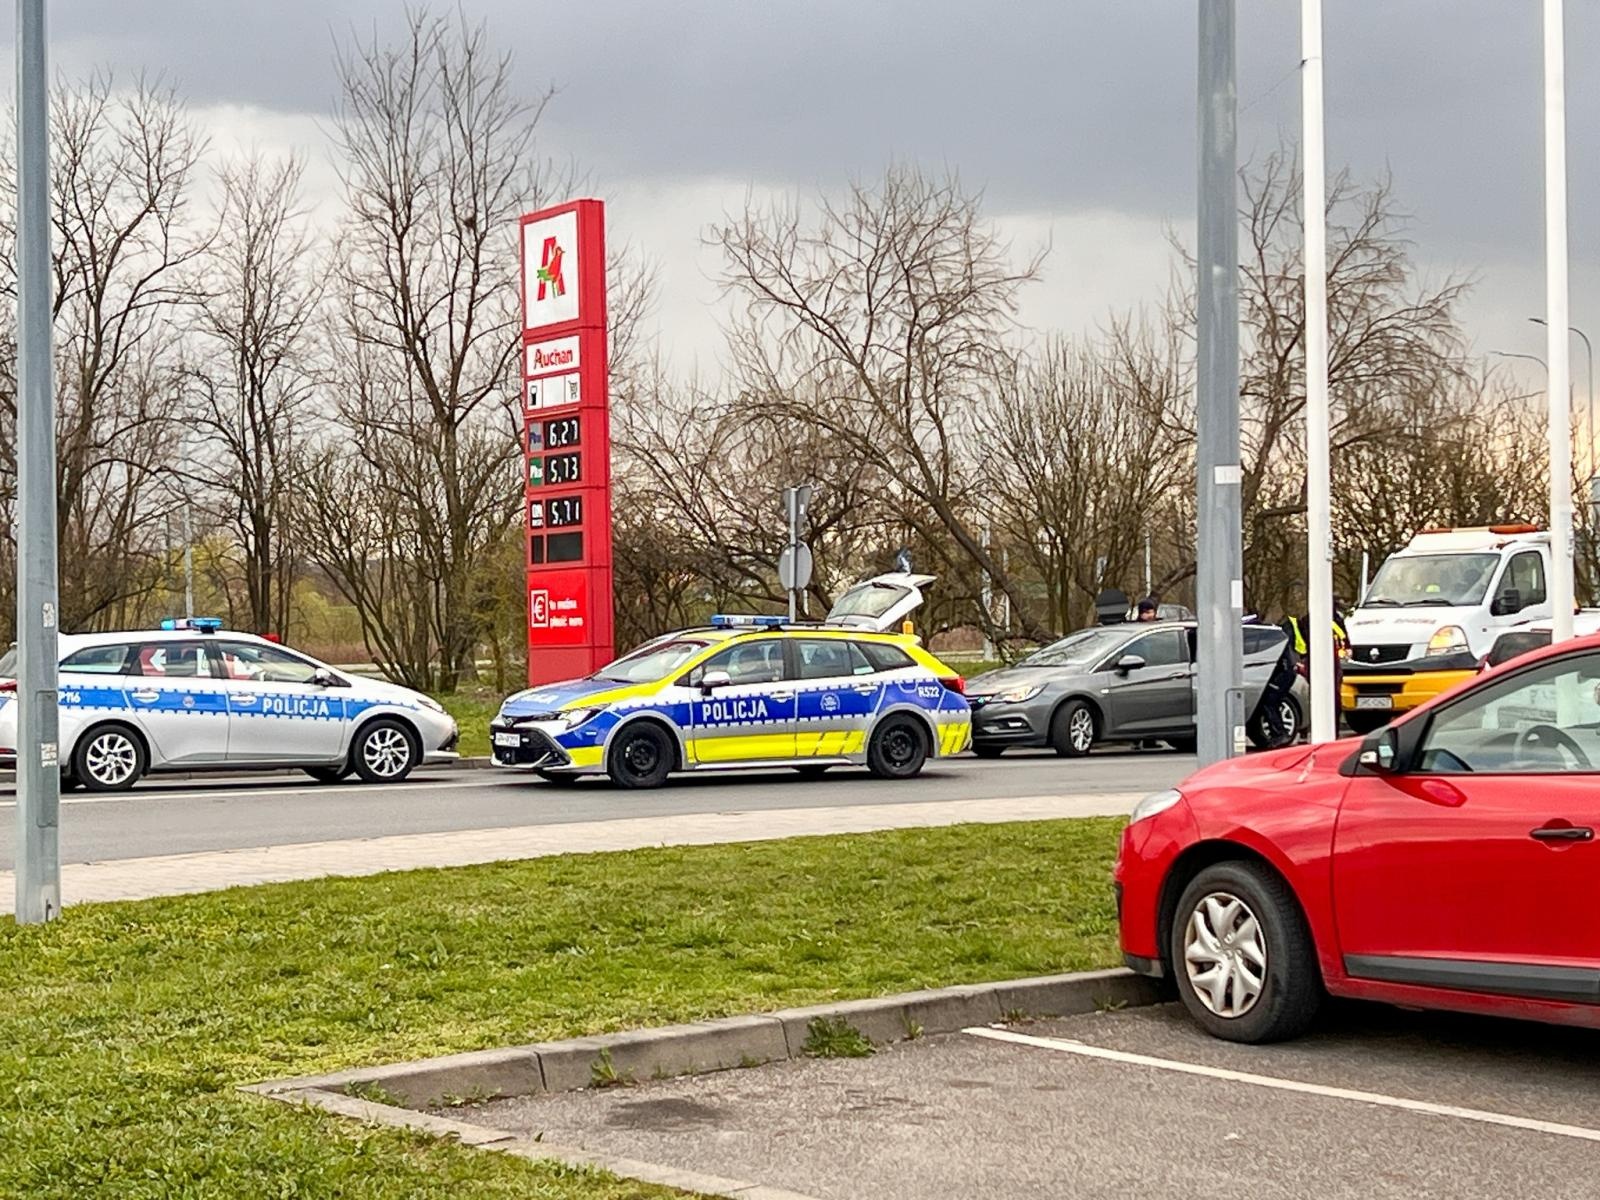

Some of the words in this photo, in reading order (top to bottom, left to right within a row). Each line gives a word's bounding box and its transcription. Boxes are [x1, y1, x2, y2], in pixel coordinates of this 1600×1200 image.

[533, 348, 573, 370] Auchan
[262, 697, 329, 716] POLICJA
[702, 699, 768, 721] POLICJA
